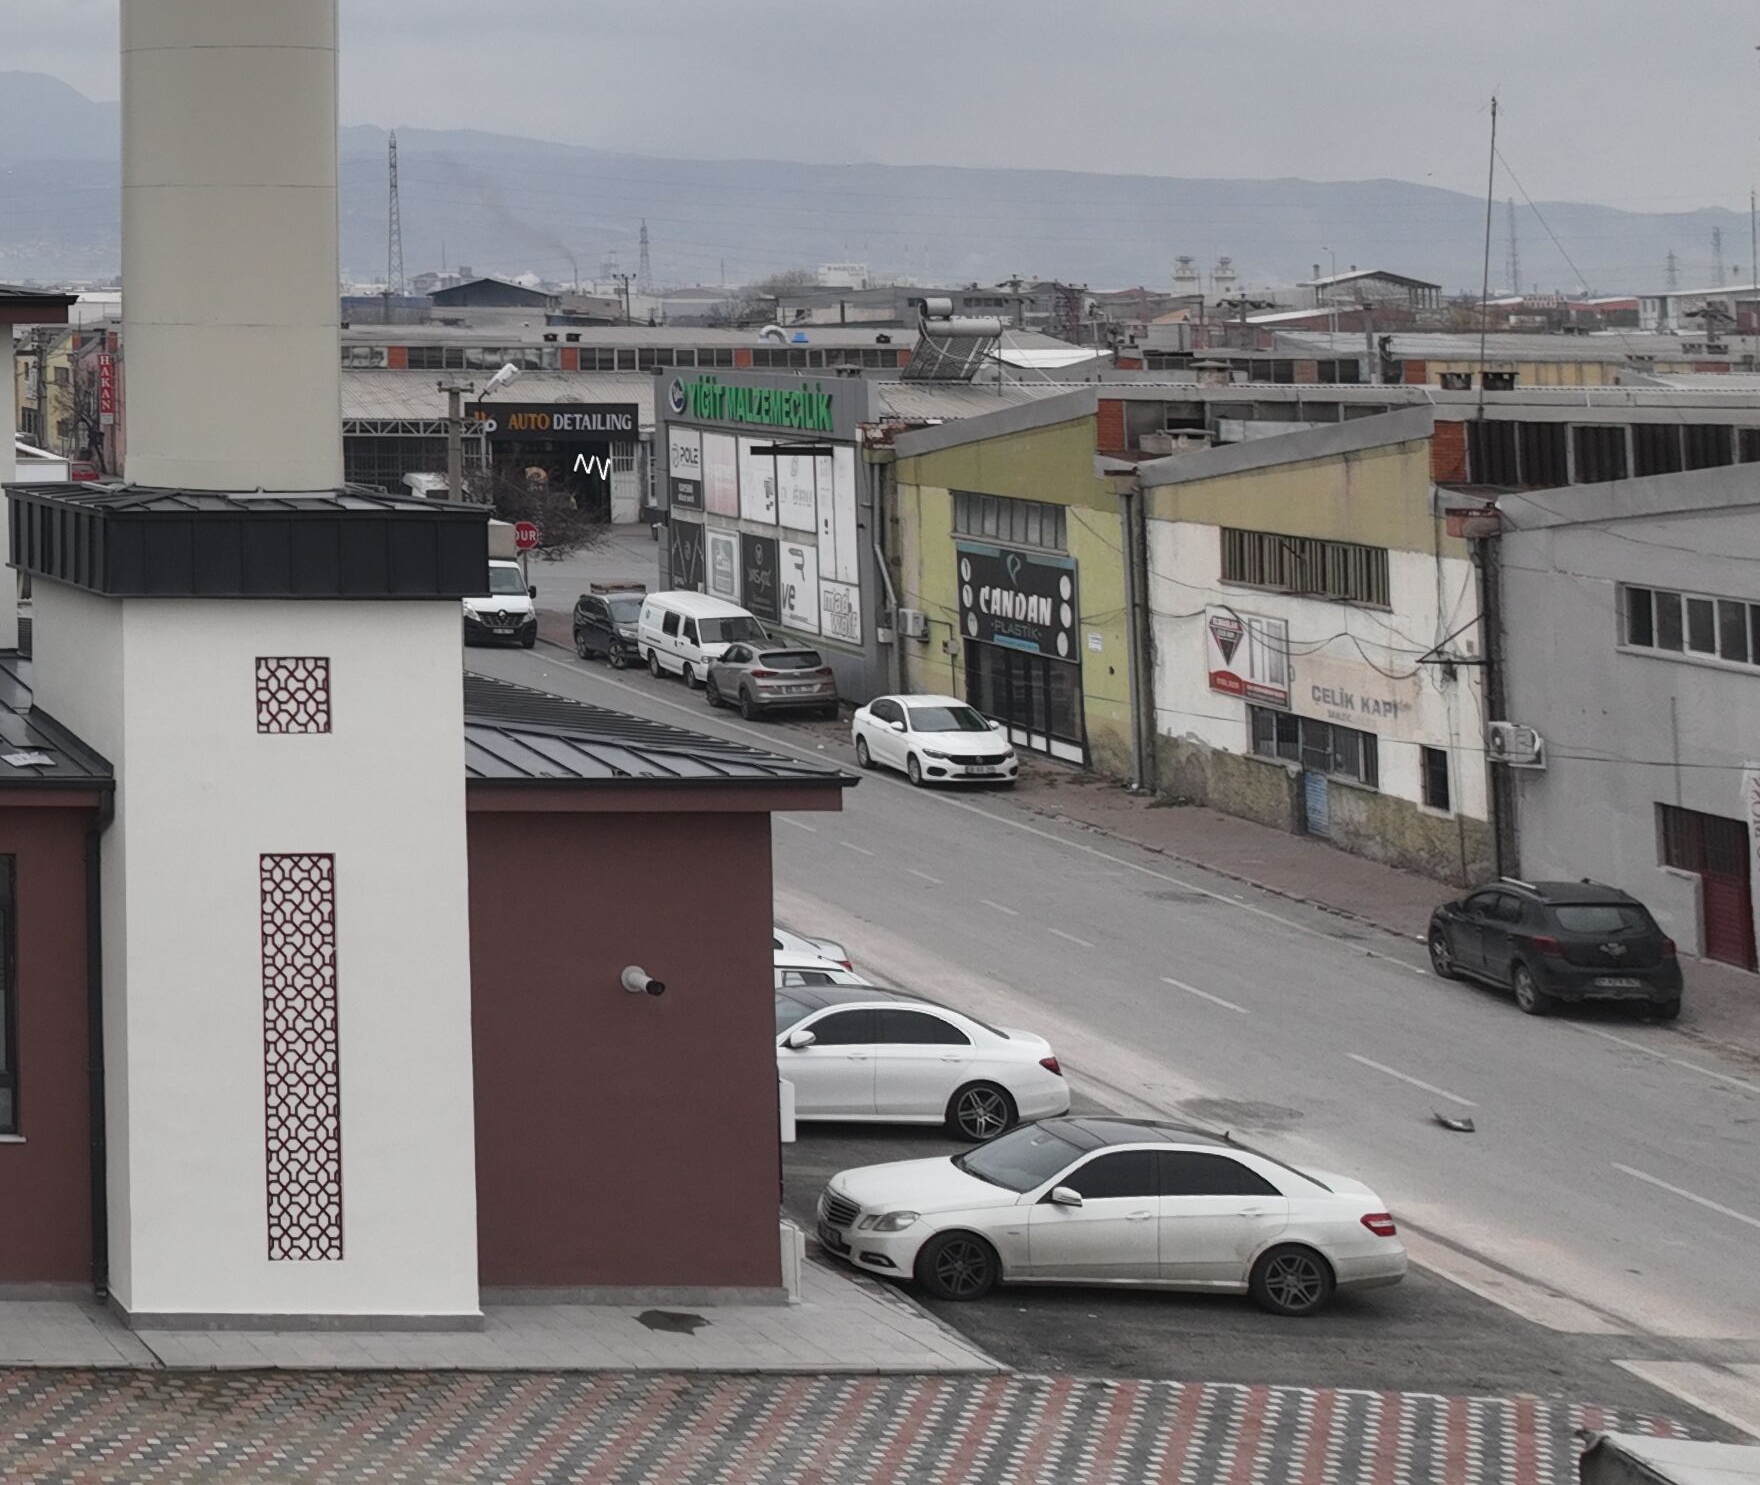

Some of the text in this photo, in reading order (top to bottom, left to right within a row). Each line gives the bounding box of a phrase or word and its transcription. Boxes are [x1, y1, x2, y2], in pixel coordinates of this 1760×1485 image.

[99, 355, 113, 412] HAKAN
[508, 413, 633, 431] AUTO DETAILING
[687, 375, 834, 432] YİĞİT MALZEMECİLİK
[680, 446, 699, 465] POLE
[979, 585, 1052, 626] CANDAN
[1311, 685, 1355, 711] ÇELİK
[1361, 697, 1399, 720] KAPI
